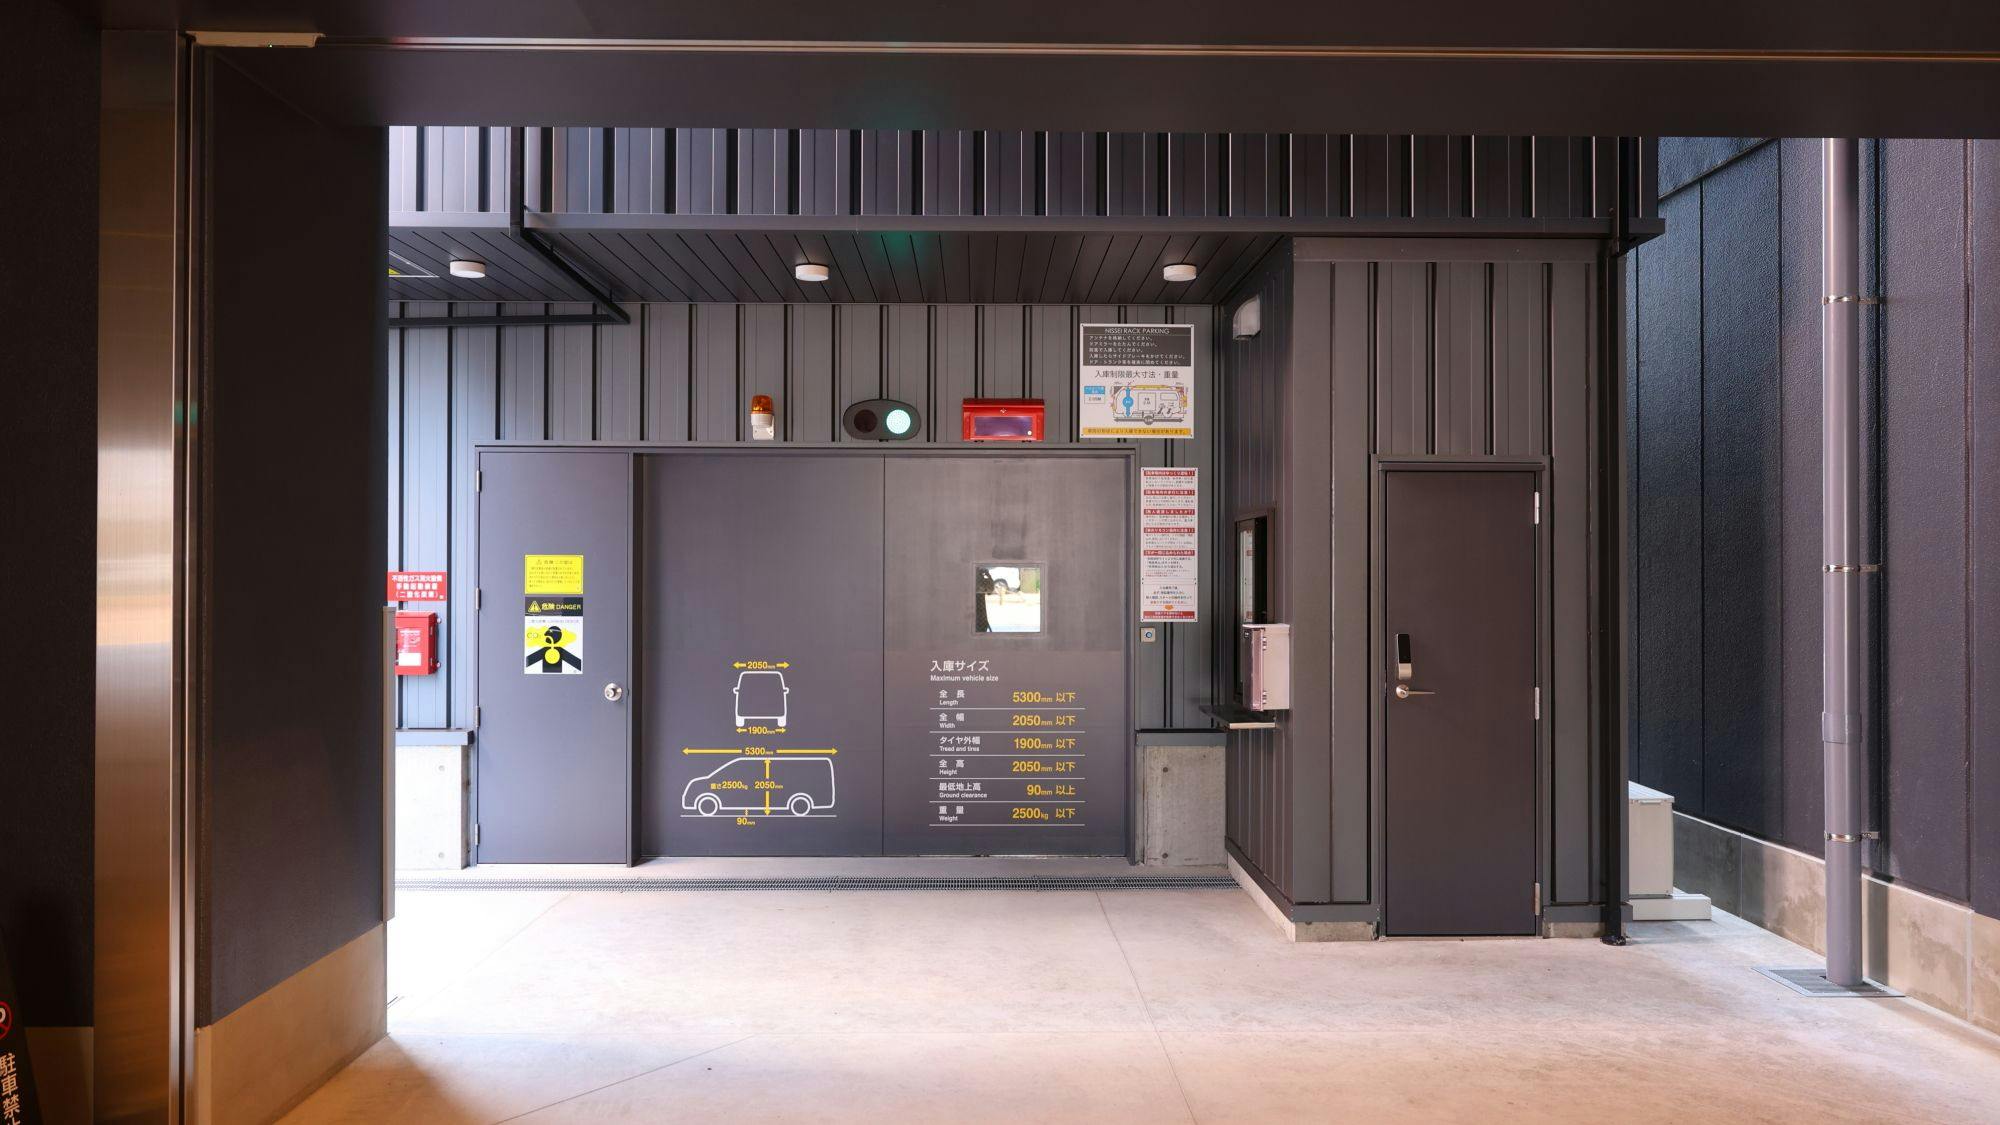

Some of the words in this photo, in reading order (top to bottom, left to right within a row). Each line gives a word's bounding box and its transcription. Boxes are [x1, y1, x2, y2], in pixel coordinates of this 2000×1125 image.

[930, 660, 990, 672] 入庫サイズ
[962, 674, 985, 682] vehicle
[1056, 692, 1076, 702] 以下
[1056, 715, 1076, 726] 以下
[1056, 738, 1076, 749] 以下
[1056, 761, 1076, 772] 以下
[1056, 785, 1076, 795] 以上
[1056, 808, 1076, 819] 以下
